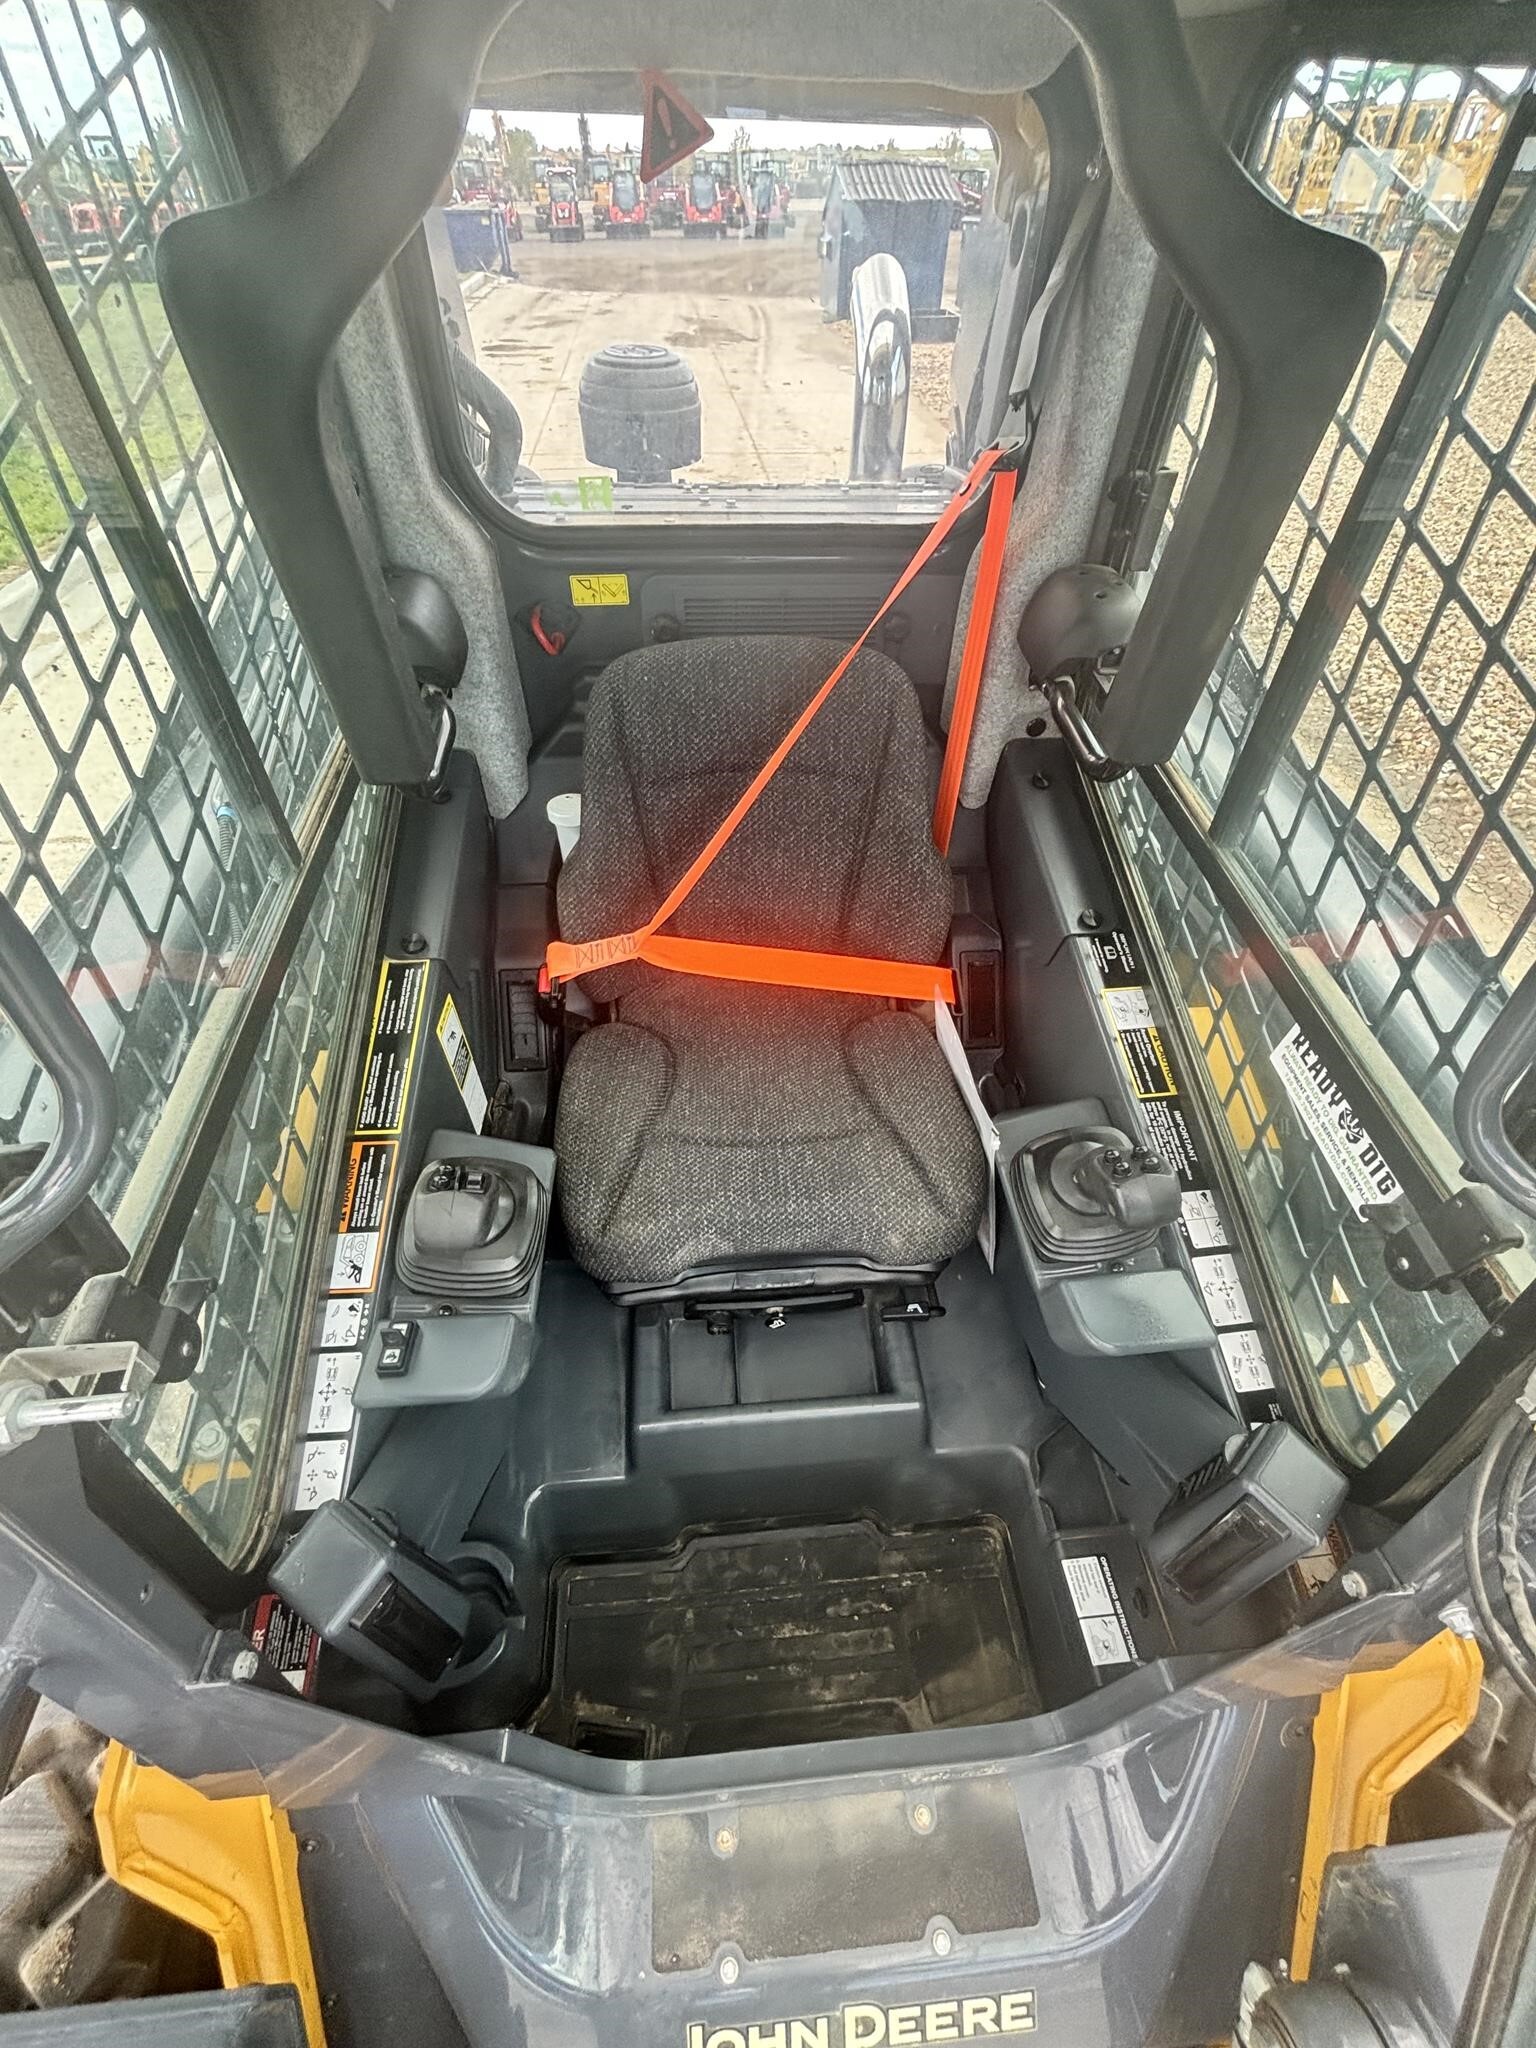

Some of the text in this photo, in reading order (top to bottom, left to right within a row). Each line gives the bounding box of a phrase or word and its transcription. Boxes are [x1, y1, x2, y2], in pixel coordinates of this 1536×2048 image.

[1281, 1053, 1307, 1095] EQUIPMENT
[1284, 1045, 1305, 1077] ALWAYS
[1304, 1075, 1322, 1104] READY
[1320, 1103, 1330, 1118] TO
[1173, 1110, 1197, 1162] IMPORTANT
[1292, 1031, 1396, 1195] READY DIG
[343, 1158, 357, 1208] WARNING
[1100, 1556, 1119, 1600] OPERATING
[688, 1992, 1035, 2048] JOHN DEERE
